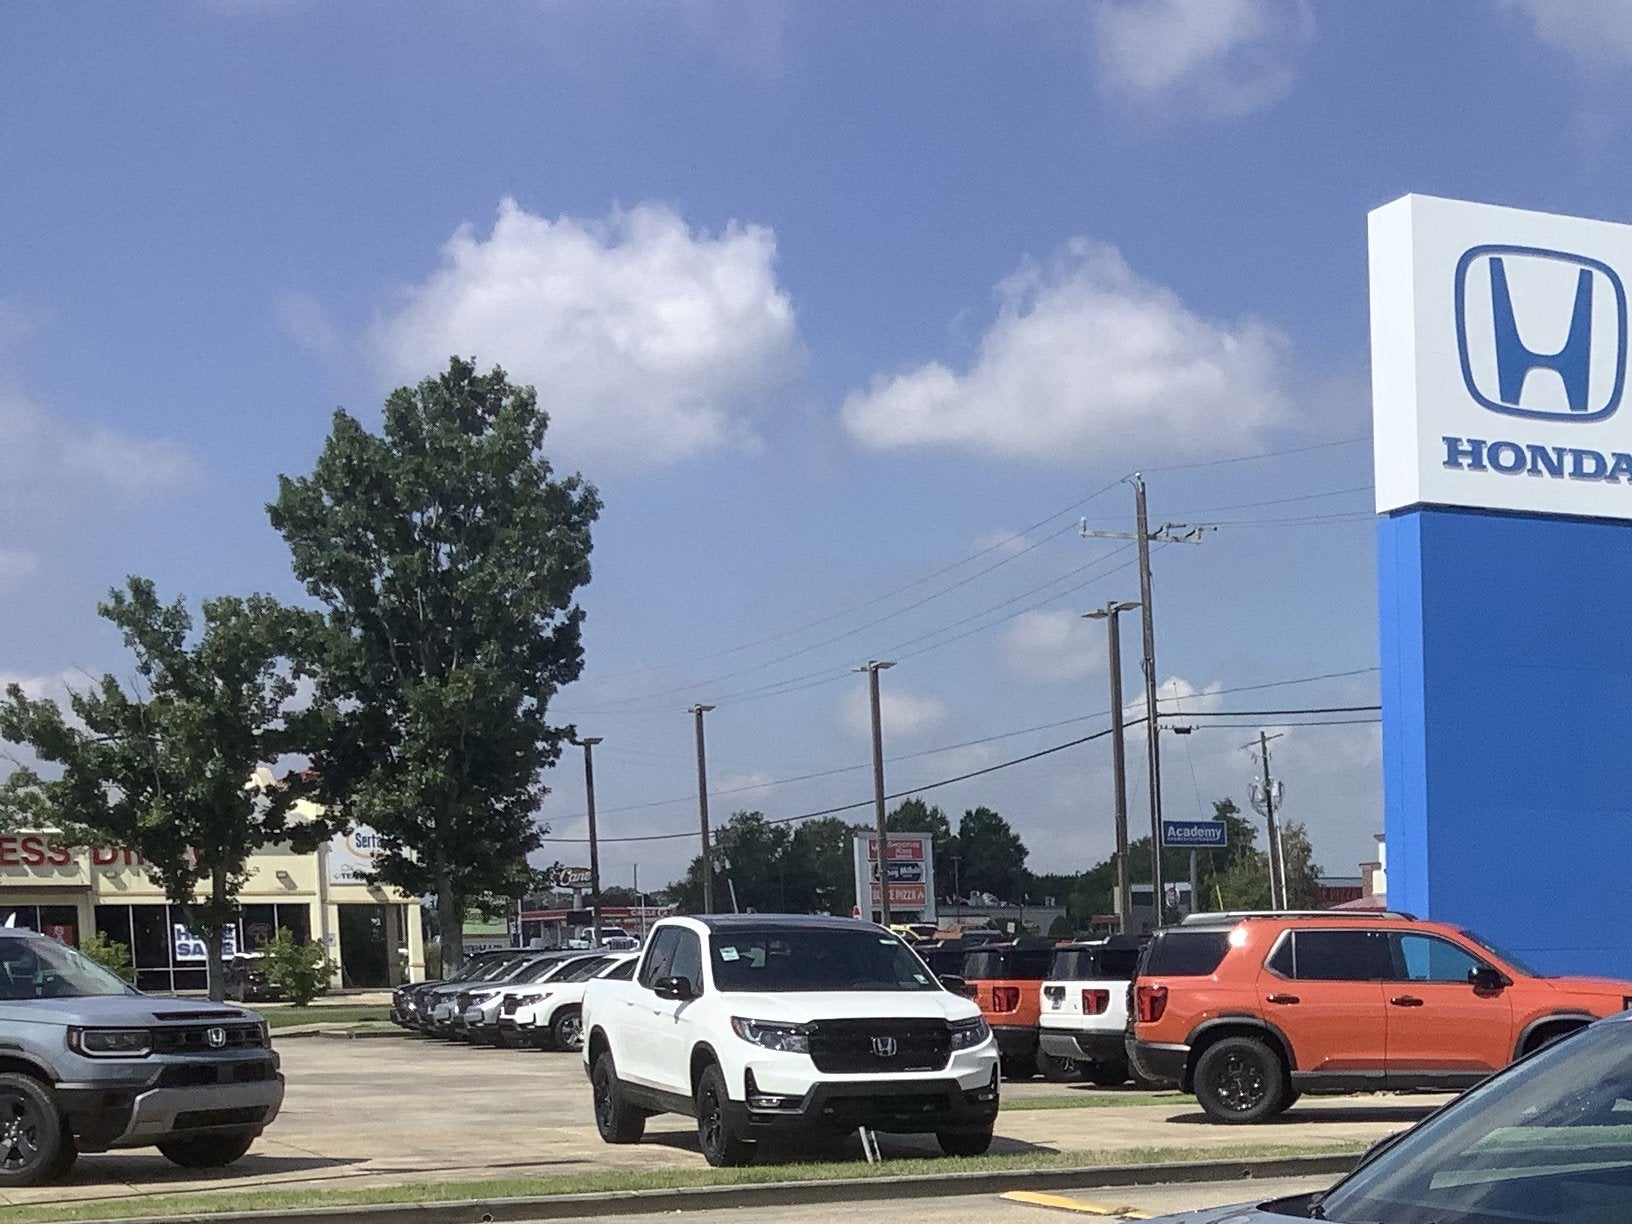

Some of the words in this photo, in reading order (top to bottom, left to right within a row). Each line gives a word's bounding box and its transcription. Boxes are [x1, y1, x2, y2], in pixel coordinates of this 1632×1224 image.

[355, 832, 383, 848] Serta
[1167, 825, 1221, 840] Academy
[177, 942, 234, 956] SAE
